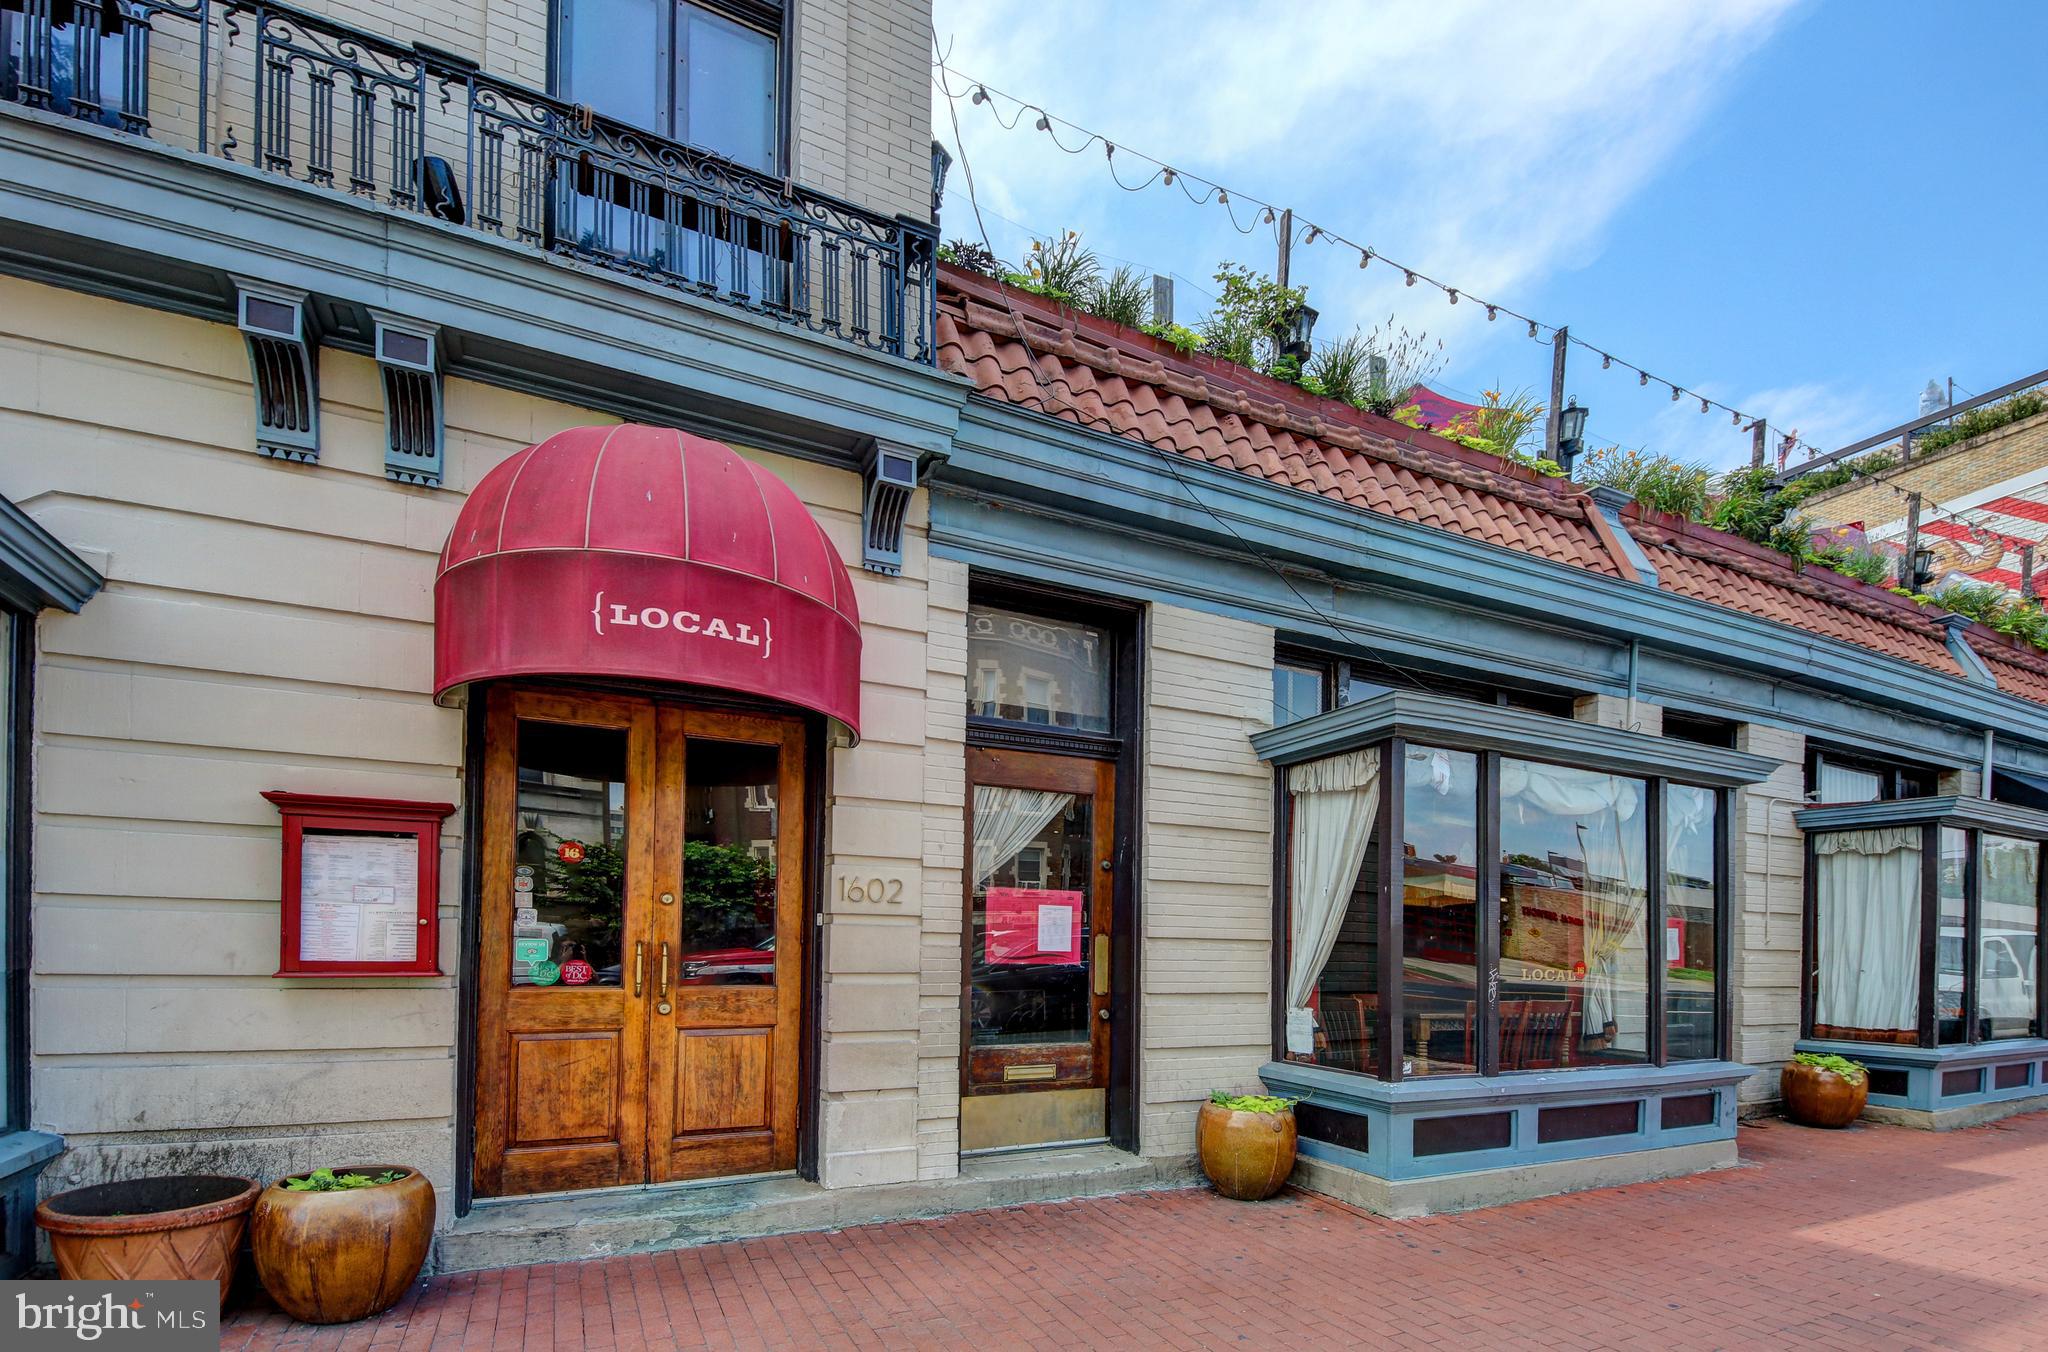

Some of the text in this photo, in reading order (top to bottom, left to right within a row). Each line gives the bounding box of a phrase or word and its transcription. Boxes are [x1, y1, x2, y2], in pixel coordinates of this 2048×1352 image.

[564, 847, 580, 858] 16
[838, 876, 903, 904] 1602
[565, 965, 588, 973] BEST
[1521, 968, 1576, 981] LOCAL
[572, 970, 588, 980] DC
